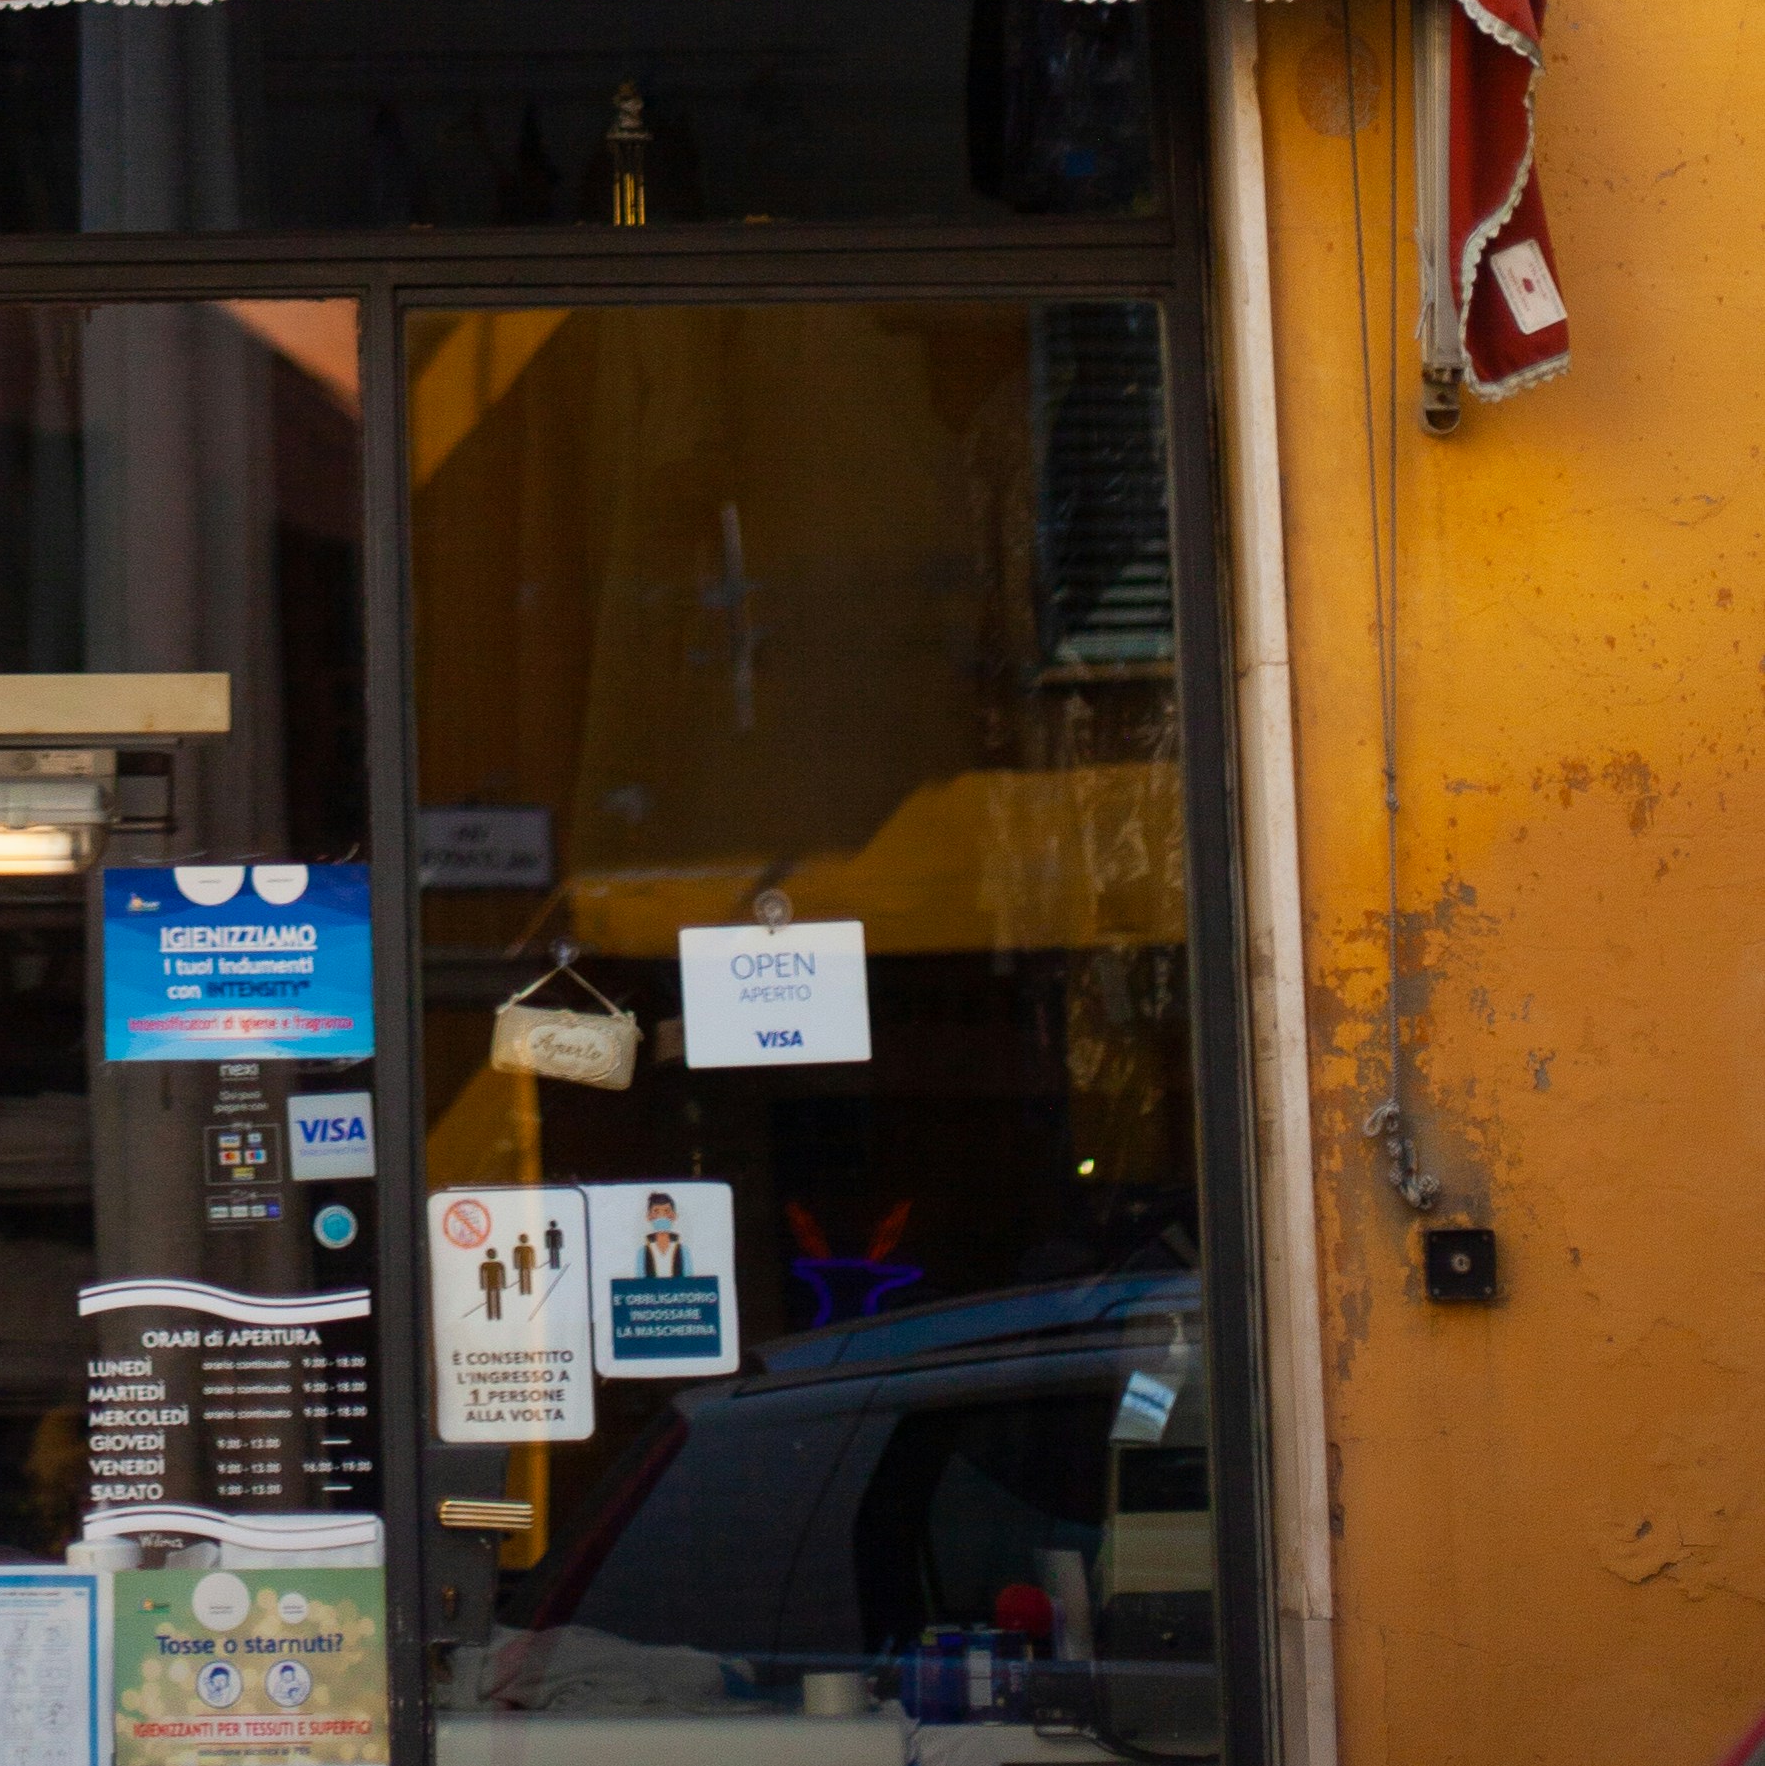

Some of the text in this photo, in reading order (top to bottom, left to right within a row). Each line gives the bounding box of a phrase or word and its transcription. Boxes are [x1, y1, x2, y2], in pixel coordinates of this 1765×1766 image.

[160, 924, 317, 948] IGIENIZZIAMO
[218, 956, 314, 975] indumenti
[730, 952, 816, 980] OPEN
[167, 984, 202, 1000] con
[738, 983, 812, 1003] APERTO
[533, 1031, 604, 1063] Aperto
[756, 1030, 804, 1048] VISA
[298, 1117, 367, 1144] VISA
[626, 1291, 718, 1305] OBBLIGATORIO
[629, 1309, 702, 1322] INDOSSARE
[141, 1329, 322, 1348] ORARI di APERTURA
[616, 1323, 717, 1338] LA MASCHERINA
[88, 1356, 153, 1377] LUNEDÌ
[466, 1350, 574, 1366] CONSENTITO
[457, 1369, 570, 1385] L'INGRESSO A
[88, 1380, 166, 1402] MARTEDÌ
[470, 1388, 565, 1404] 1 PERSONE
[88, 1405, 189, 1427] MERCOLEDÌ
[465, 1407, 564, 1422] ALLA VOLTA
[89, 1430, 166, 1452] GIOVEDÌ
[89, 1454, 166, 1476] VENERDÌ
[90, 1483, 164, 1501] SABATO
[155, 1633, 343, 1655] Tosse o starnuti?
[134, 1723, 213, 1738] IGIENIZZANTI
[217, 1722, 239, 1736] PER
[245, 1721, 295, 1736] TESSUTI
[298, 1721, 306, 1735] E
